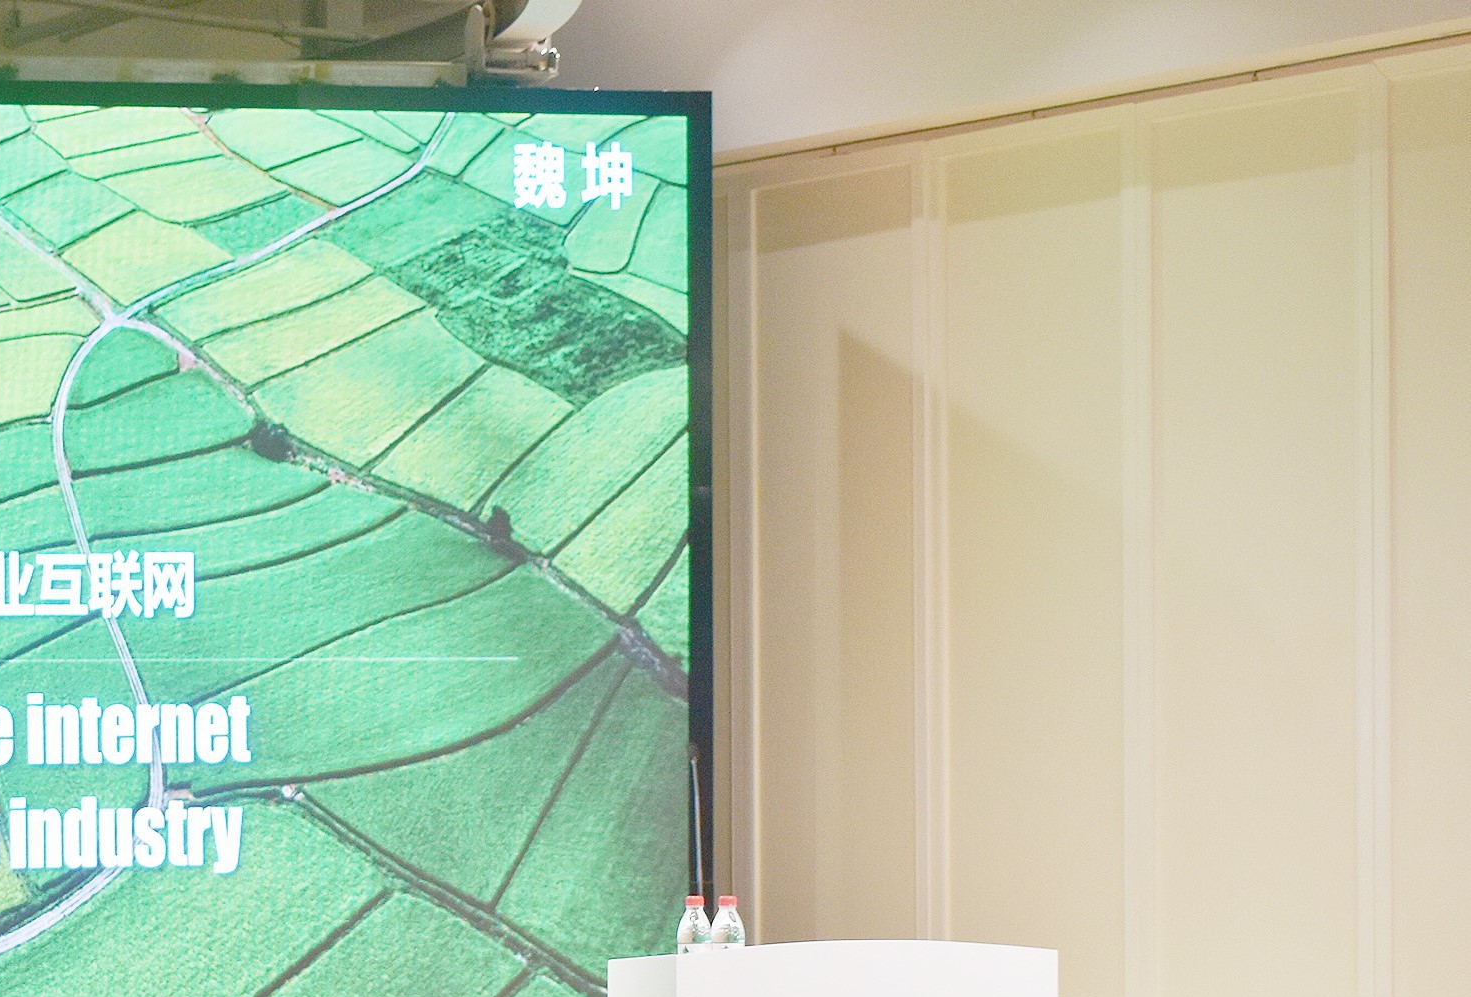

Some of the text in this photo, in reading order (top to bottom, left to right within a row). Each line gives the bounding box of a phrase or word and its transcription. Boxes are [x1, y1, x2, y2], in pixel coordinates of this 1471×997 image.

[513, 141, 633, 210] 魏 坤
[27, 692, 251, 764] internet
[9, 798, 243, 874] industry
